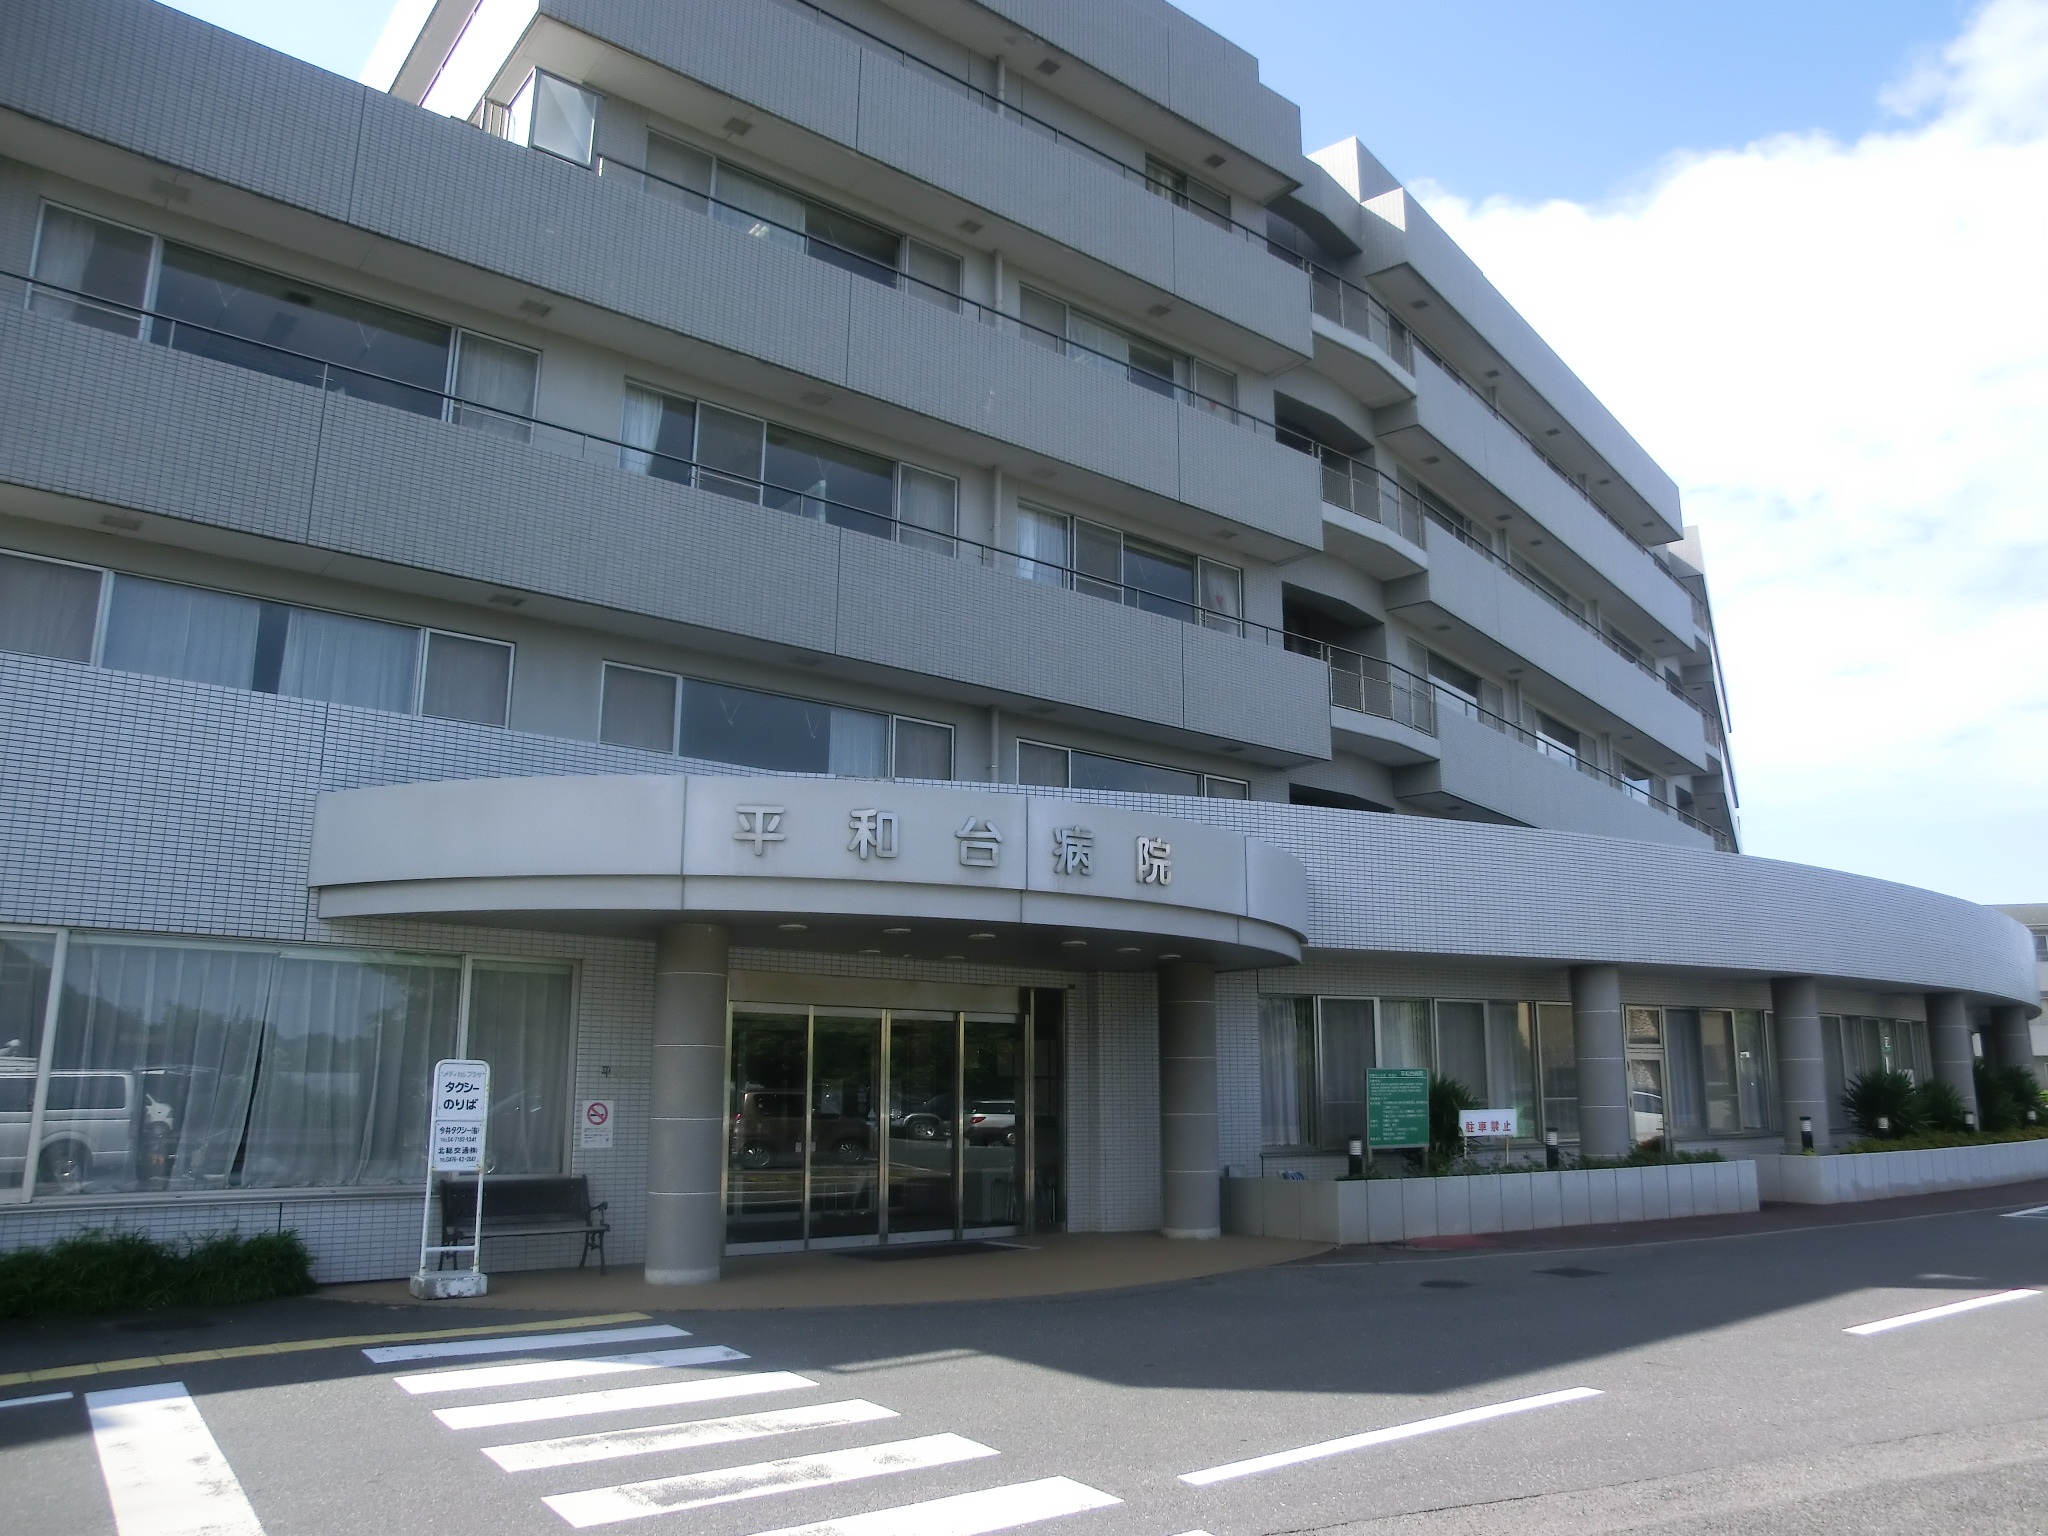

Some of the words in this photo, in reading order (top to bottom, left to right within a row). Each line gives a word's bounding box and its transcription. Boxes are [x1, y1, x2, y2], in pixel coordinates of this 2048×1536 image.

[733, 804, 1171, 886] 平和台病院
[445, 1081, 480, 1093] タクシー
[443, 1098, 479, 1110] のりば
[1465, 1119, 1511, 1132] 駐車禁止
